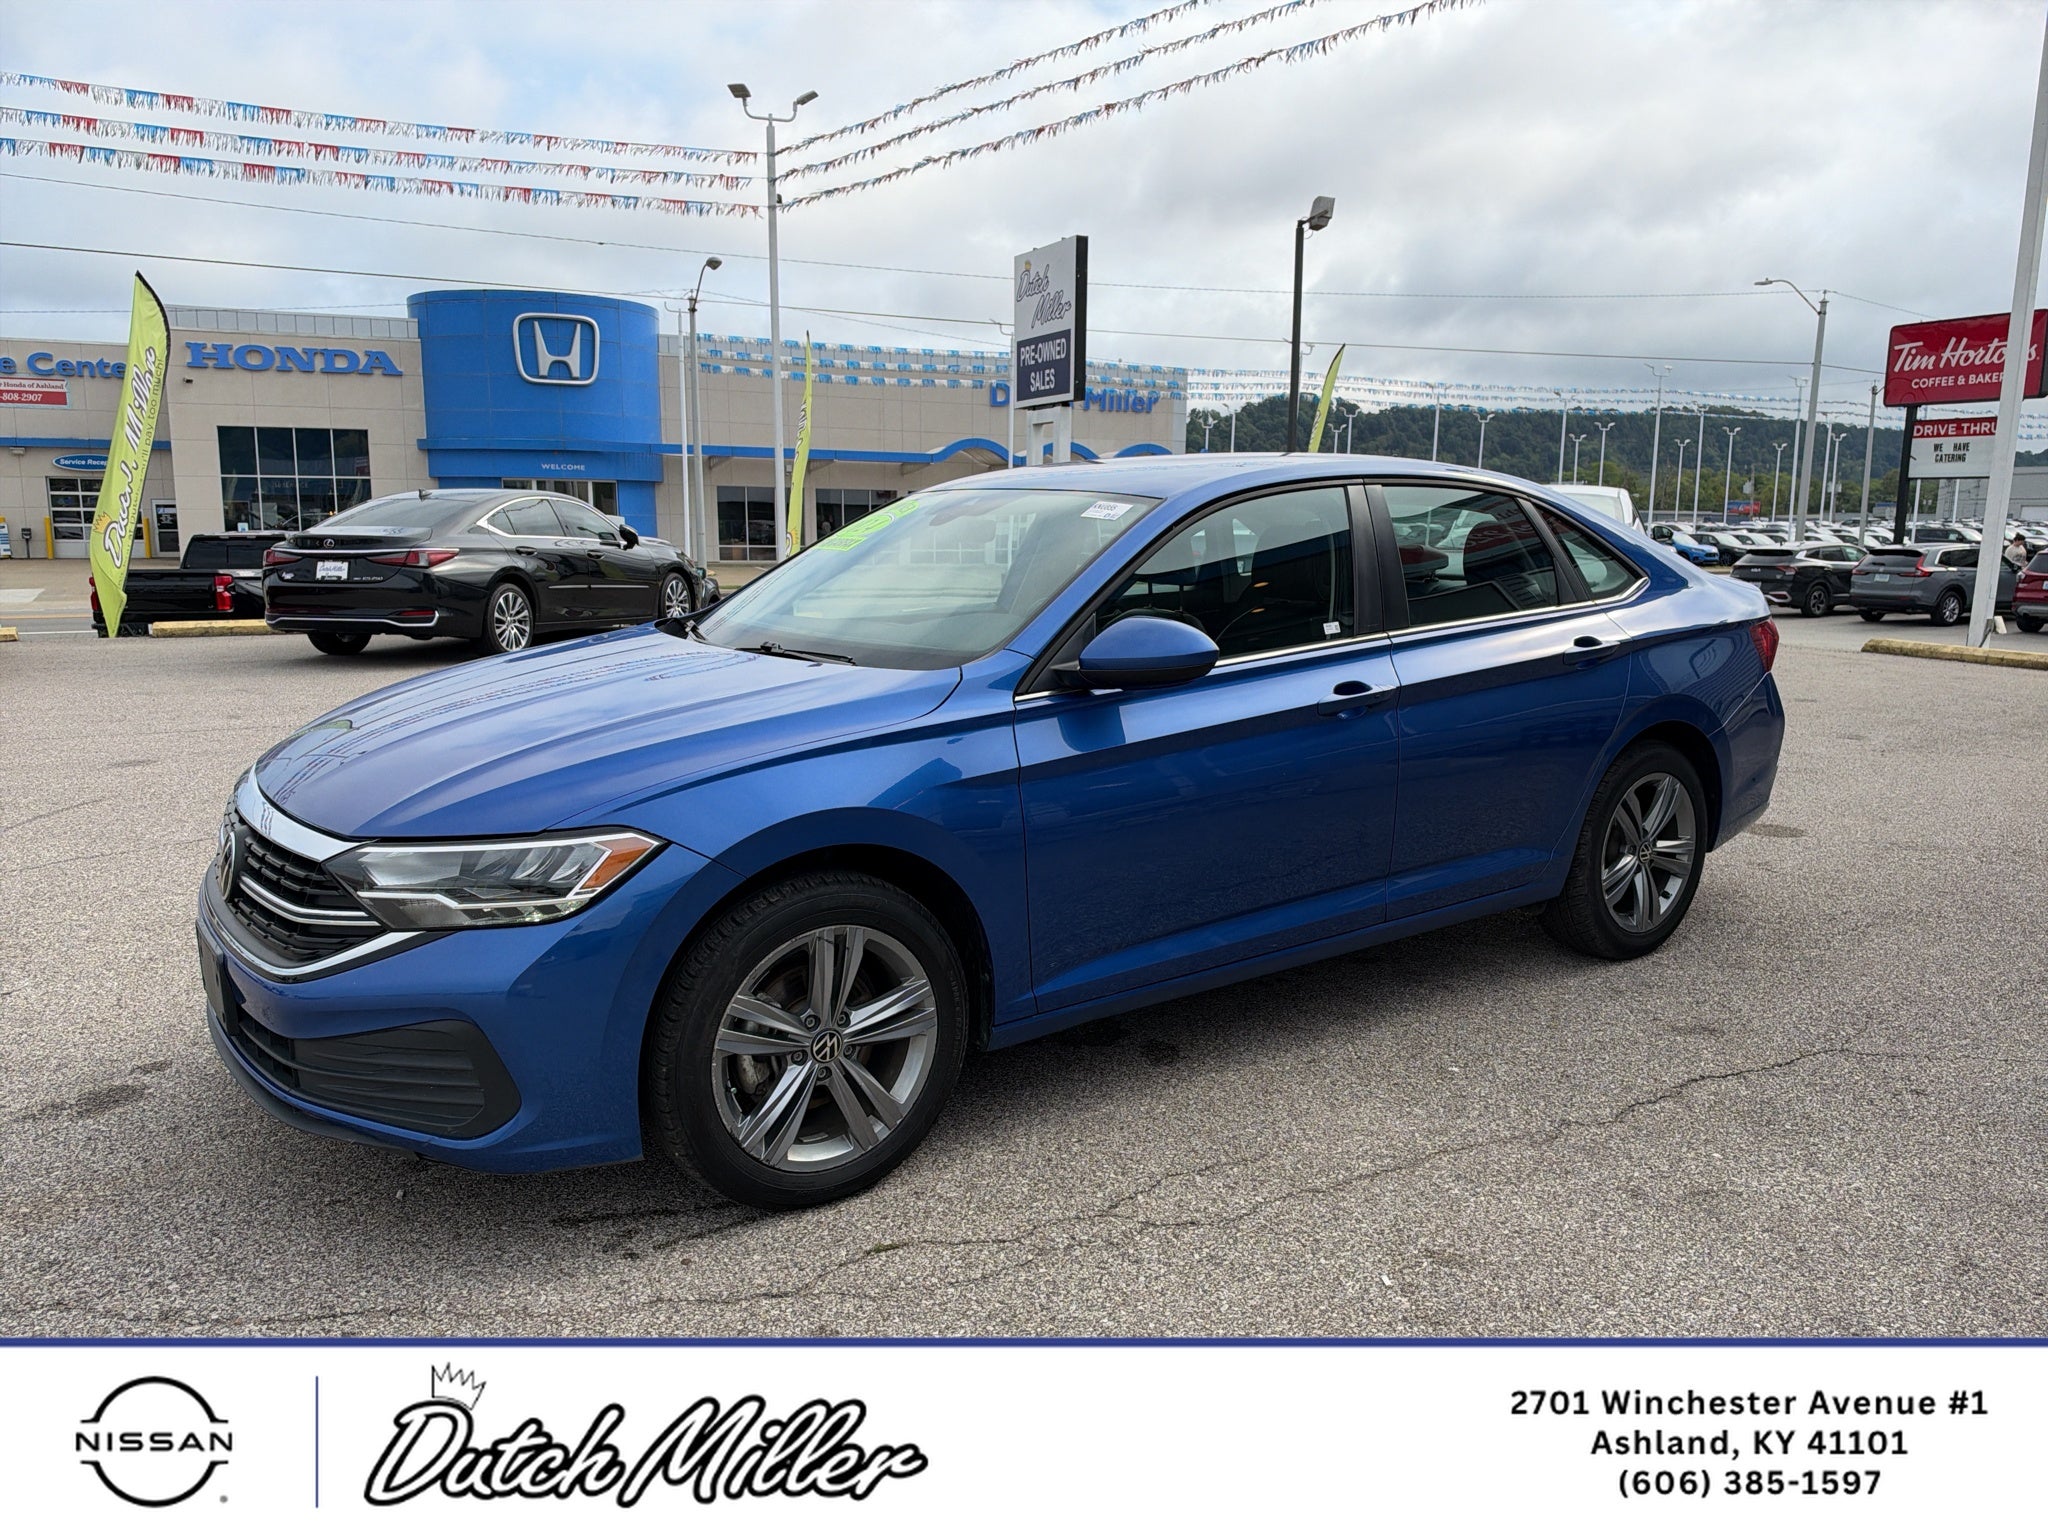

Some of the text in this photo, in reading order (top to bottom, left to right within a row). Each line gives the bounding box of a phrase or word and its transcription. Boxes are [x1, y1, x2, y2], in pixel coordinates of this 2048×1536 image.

[1016, 264, 1050, 303] Dutch
[1031, 289, 1072, 329] Miller
[185, 341, 404, 376] HONDA
[1020, 337, 1067, 367] PRE-OWNED
[1893, 336, 2038, 373] Tim Hortos
[26, 351, 127, 379] Cente
[3, 381, 27, 389] Honda
[36, 382, 65, 390] Ashland
[1030, 369, 1056, 392] SALES
[1911, 371, 2004, 389] COFFEE & BAKER
[148, 399, 157, 420] too
[1084, 387, 1161, 413] Miller
[145, 423, 154, 447] pay
[1913, 423, 1957, 437] DRIVE
[1933, 441, 1970, 453] WE HAVE
[1934, 453, 1967, 463] CATERING
[59, 457, 86, 465] Service
[541, 463, 586, 472] WELCOME
